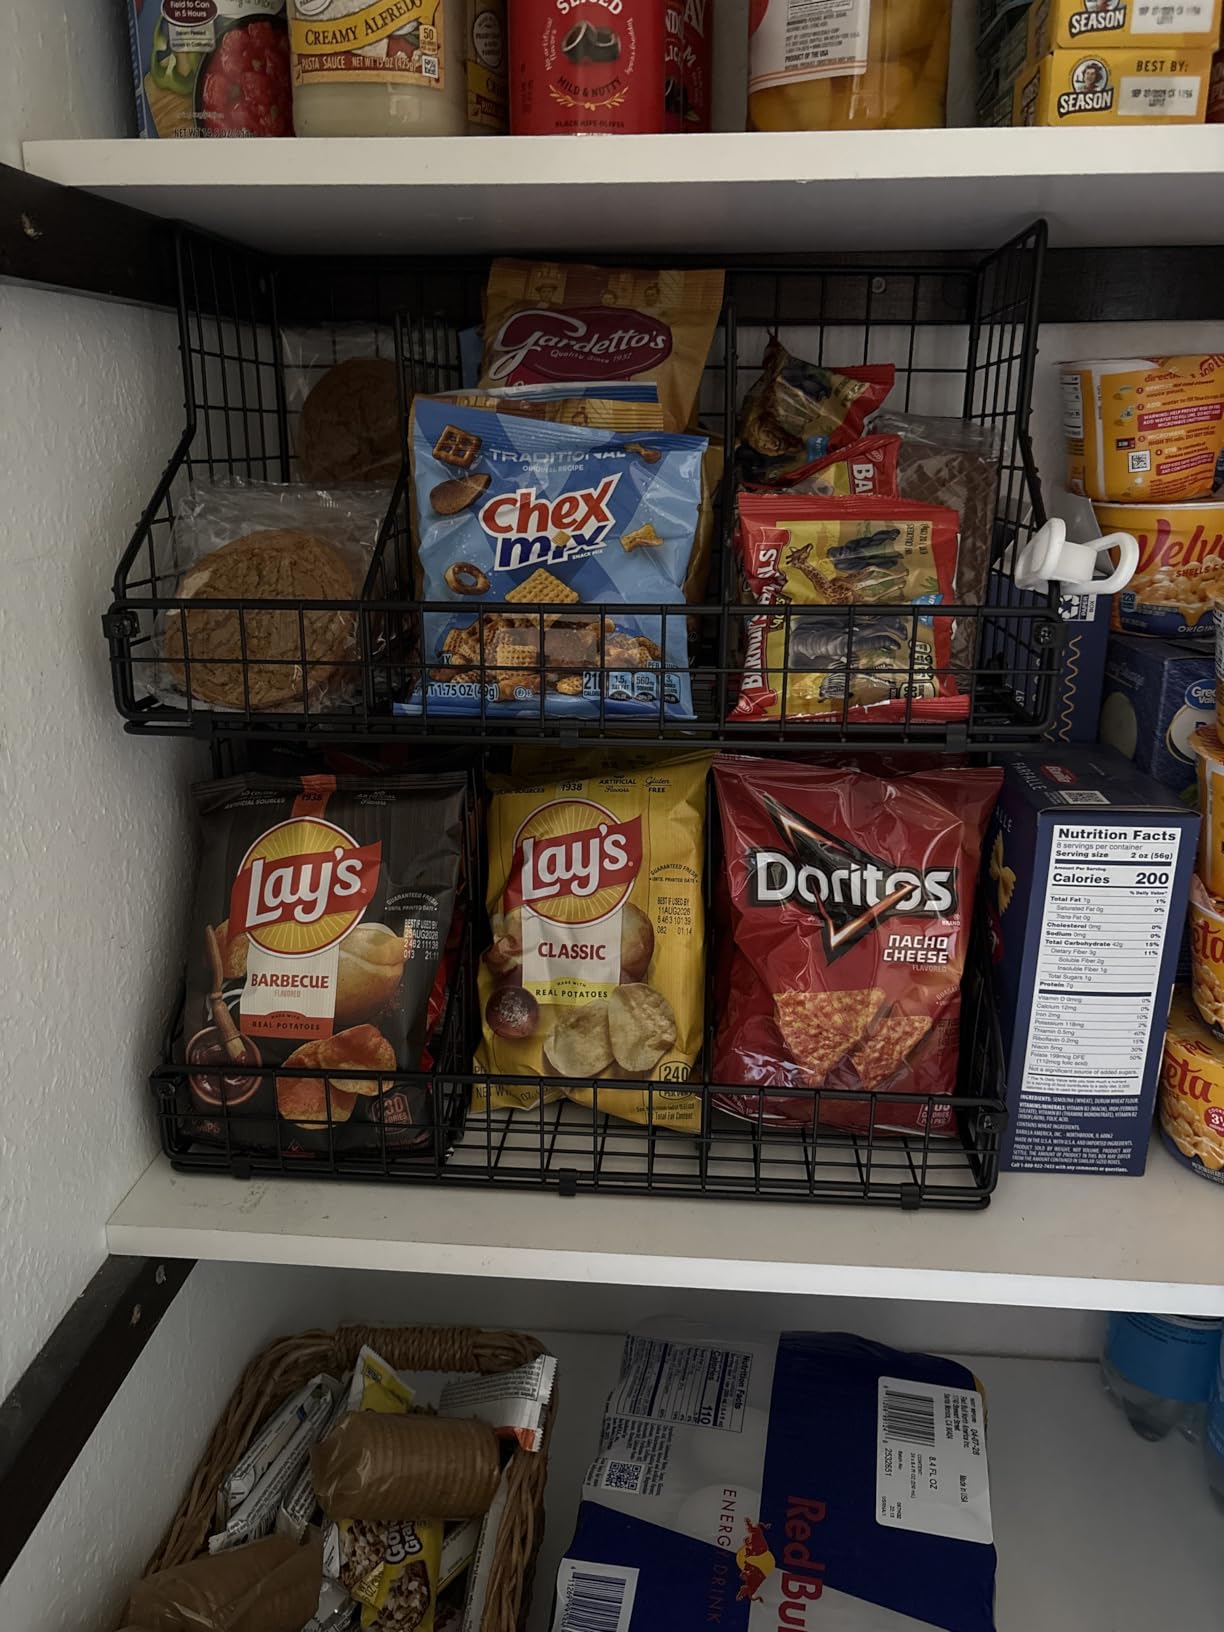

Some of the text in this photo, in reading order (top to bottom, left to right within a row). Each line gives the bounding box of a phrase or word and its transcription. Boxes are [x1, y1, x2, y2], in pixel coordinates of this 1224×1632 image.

[305, 0, 423, 46] CREAMY ALFREDO
[1071, 10, 1126, 34] SEASON
[424, 28, 434, 41] 50
[302, 58, 320, 70] PASTA
[323, 56, 345, 69] SAUCE
[352, 56, 364, 68] NET
[365, 57, 375, 68] WT
[385, 57, 394, 68] OZ
[785, 54, 804, 63] PRODUCT
[1136, 60, 1189, 72] BEST BY:
[557, 76, 622, 97] MILD & NUTTY
[1060, 92, 1112, 113] SEASON
[488, 310, 666, 380] Gardetto's
[489, 448, 626, 464] TRADITIONAL
[482, 479, 615, 534] Chex
[498, 525, 608, 569] mix
[1135, 519, 1224, 574] Velv
[1176, 566, 1210, 578] SHELLS
[1080, 596, 1088, 616] PAPER
[436, 684, 457, 697] 1.75
[458, 684, 473, 697] OZ
[561, 782, 583, 792] 1938
[1058, 828, 1176, 841] Nutrition Facts
[1064, 842, 1094, 851] servings
[521, 822, 628, 900] Lay's
[1150, 852, 1173, 860] (56g)
[756, 851, 953, 912] Doritos
[1053, 872, 1169, 884] Calories 200
[245, 846, 363, 928] Lay's
[404, 918, 416, 928] BEST
[888, 935, 949, 949] NACHO
[1065, 940, 1111, 948] Carbohydrate
[538, 942, 606, 960] CLASSIC
[883, 948, 949, 964] CHEESE
[912, 965, 947, 973] FLAVORED
[250, 974, 329, 990] BARBECUE
[535, 989, 608, 999] REAL POTATOES
[252, 1020, 321, 1031] REAL POTATOES
[663, 1066, 689, 1082] 240
[701, 1350, 722, 1425] Calories 110
[735, 1354, 750, 1410] Nutrition Facts
[929, 1468, 937, 1477] FL
[930, 1479, 937, 1490] OZ
[783, 1495, 826, 1572] Red
[706, 1564, 728, 1623] DRINK
